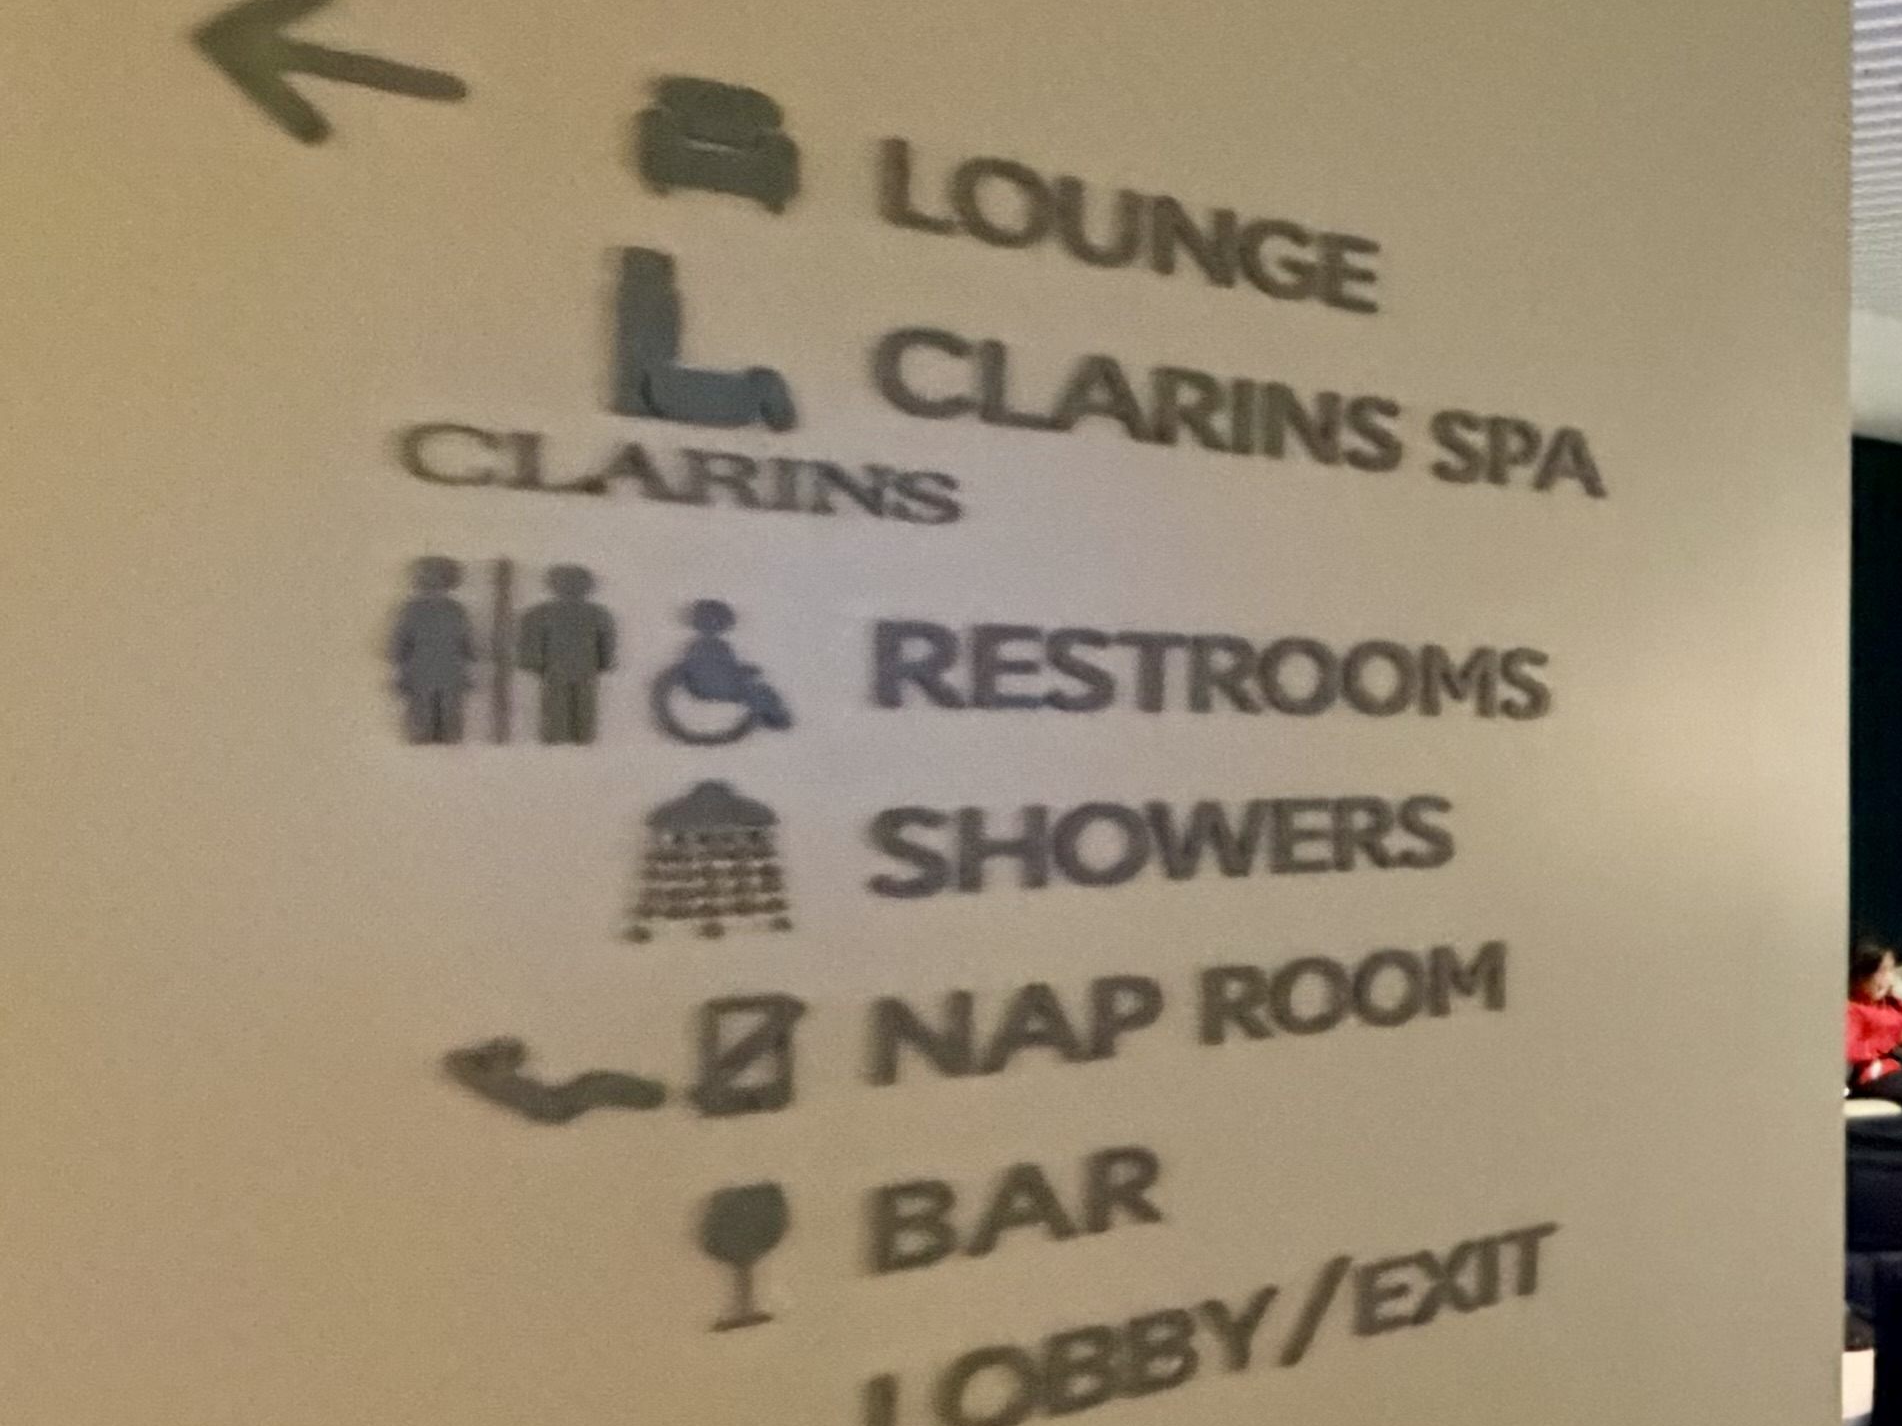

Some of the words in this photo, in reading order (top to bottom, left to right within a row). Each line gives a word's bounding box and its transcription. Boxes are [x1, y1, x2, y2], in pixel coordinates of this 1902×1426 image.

[876, 135, 1382, 315] LOUNGE
[390, 421, 966, 526] CLARINS
[868, 325, 1404, 474] CLARINS
[1427, 407, 1609, 499] SPA
[868, 618, 1553, 722] RESTROOMS
[867, 793, 1457, 900] SHOWERS
[867, 972, 1165, 1088] NAP
[1199, 939, 1508, 1047] ROOM
[862, 1143, 1164, 1277] BAR
